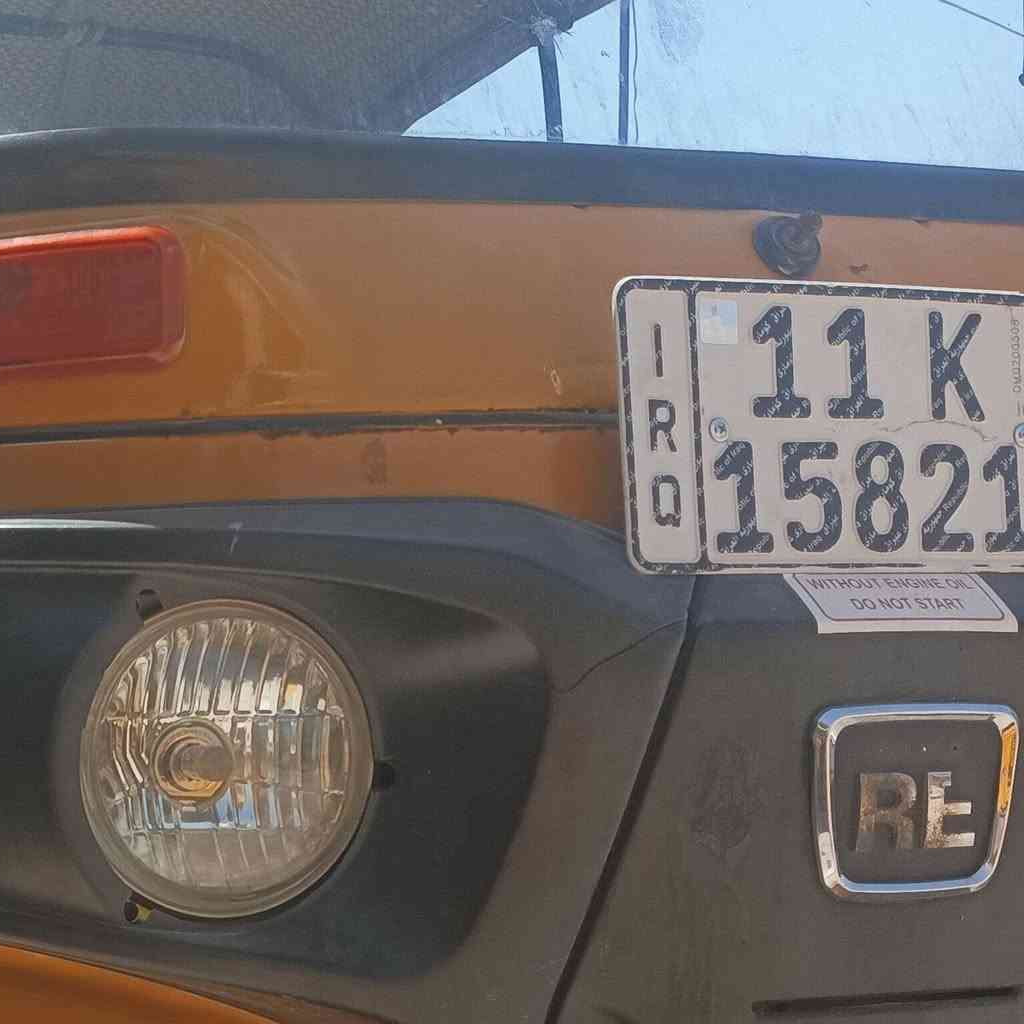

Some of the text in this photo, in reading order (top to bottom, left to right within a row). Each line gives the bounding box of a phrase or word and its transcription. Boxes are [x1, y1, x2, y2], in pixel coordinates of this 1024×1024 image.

[752, 305, 985, 422] 11 K
[648, 322, 681, 528] IRQ
[713, 440, 1024, 554] 15821
[806, 577, 977, 591] WITHOUT ENGINE OIL
[849, 597, 965, 611] DO NOT START
[856, 770, 976, 851] RE
